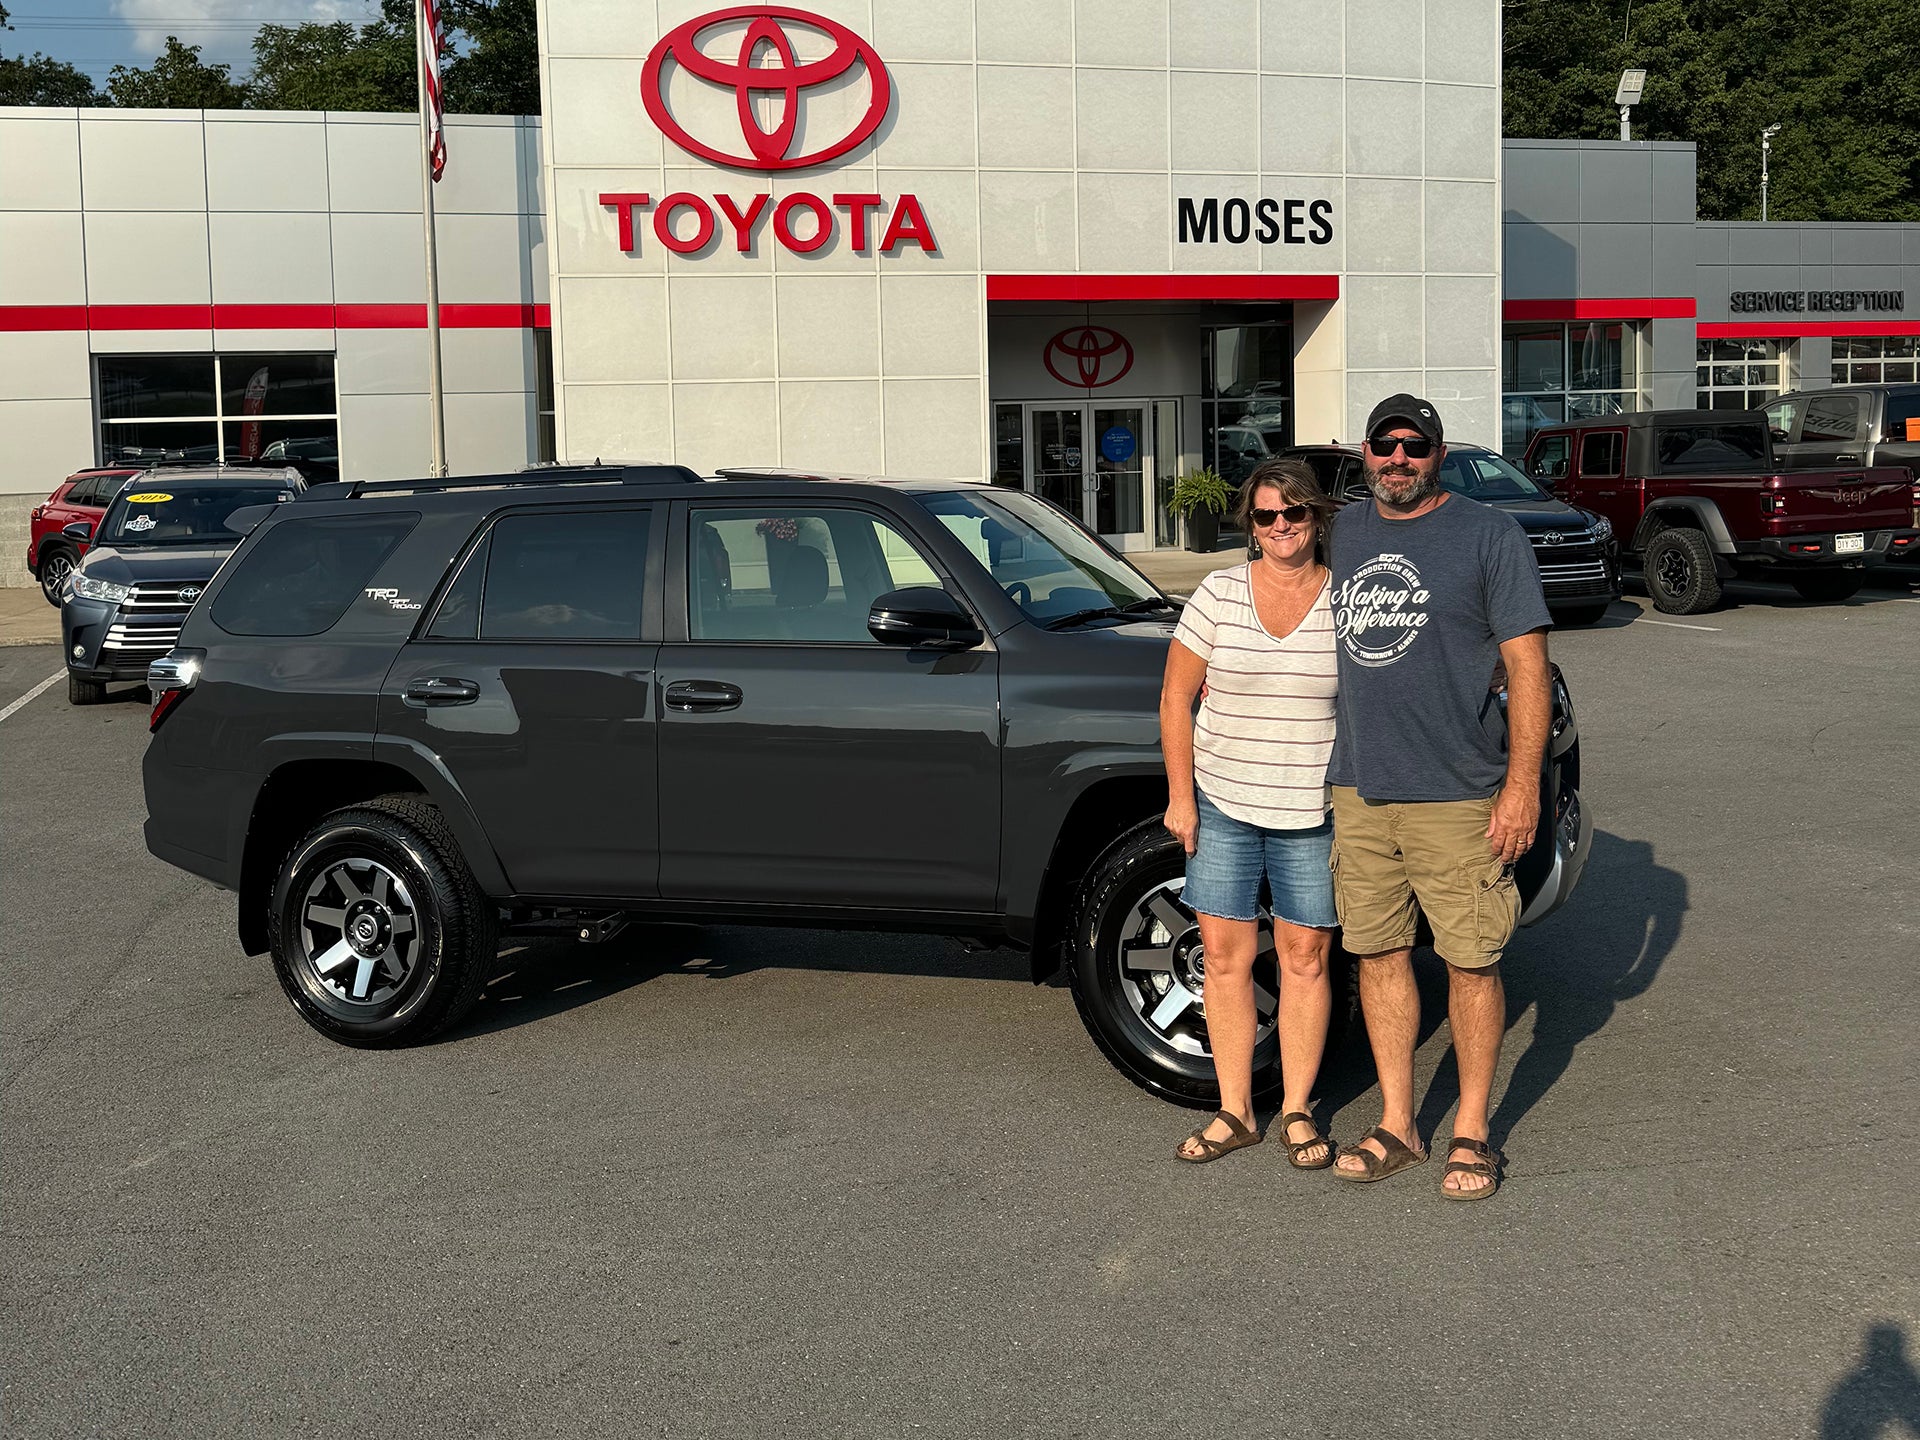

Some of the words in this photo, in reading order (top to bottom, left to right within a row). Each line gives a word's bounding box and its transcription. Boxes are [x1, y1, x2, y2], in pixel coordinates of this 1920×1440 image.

[599, 191, 937, 253] TOYOTA
[1178, 197, 1333, 245] MOSES
[1730, 291, 1805, 313] SERVICE
[1807, 290, 1905, 313] RECEPTION
[1833, 488, 1867, 504] Jeep
[1352, 562, 1403, 582] PRODUCTION
[1401, 568, 1421, 588] CREW
[365, 588, 399, 600] TRD
[1331, 579, 1410, 612] Making
[1411, 589, 1431, 604] a
[1336, 605, 1429, 639] Difference
[1359, 649, 1393, 659] TOMORROW
[1397, 629, 1419, 652] ALWAYS
